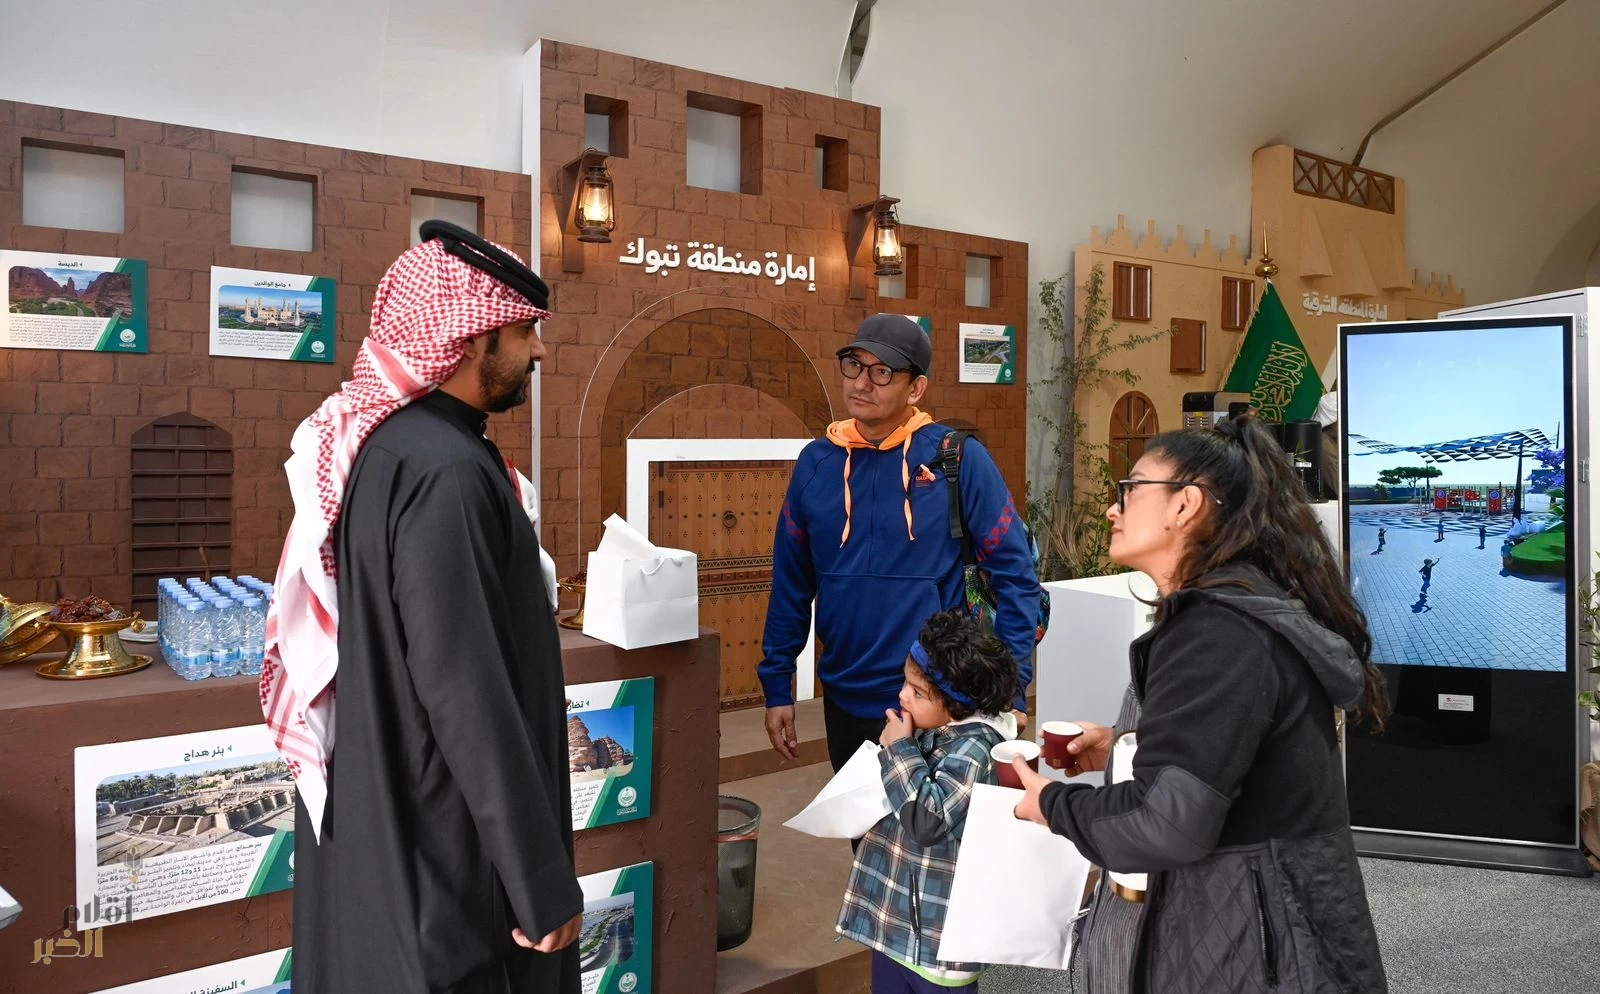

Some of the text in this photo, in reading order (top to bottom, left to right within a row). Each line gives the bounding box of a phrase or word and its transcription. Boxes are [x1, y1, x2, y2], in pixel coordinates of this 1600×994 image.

[58, 260, 78, 268] الديسة
[619, 238, 816, 292] إمارة منطقة تبوك
[1302, 291, 1338, 316] الشرقية
[184, 745, 224, 762] بئر هداج
